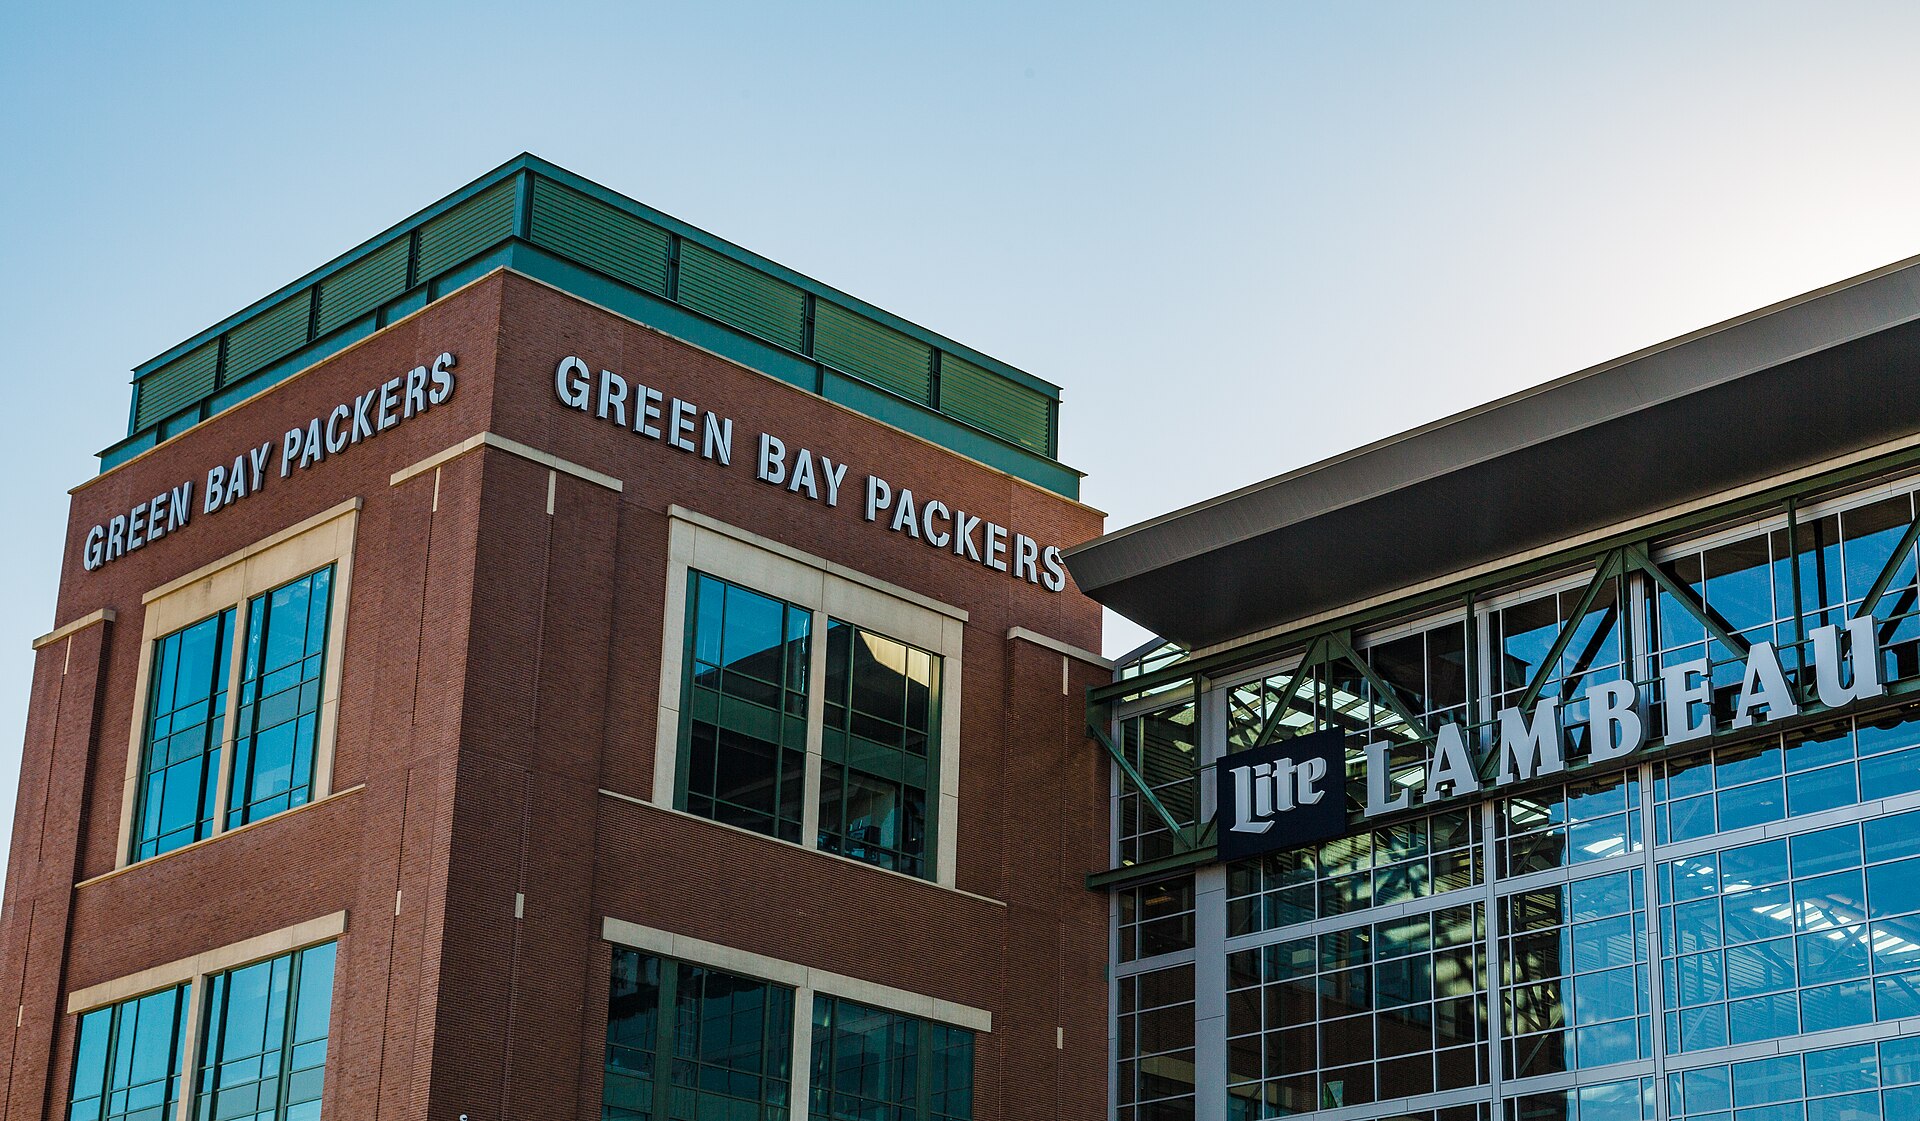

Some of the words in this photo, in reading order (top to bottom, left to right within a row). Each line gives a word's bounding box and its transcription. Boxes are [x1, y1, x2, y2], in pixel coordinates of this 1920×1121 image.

[83, 480, 194, 571] GREEN
[203, 441, 273, 514] BAY
[280, 352, 456, 477] PACKERS
[554, 355, 733, 466] GREEN
[756, 432, 848, 507] BAY
[865, 474, 1066, 592] PACKERS
[1229, 757, 1327, 834] Lite
[1363, 615, 1885, 817] LAMBEAU
